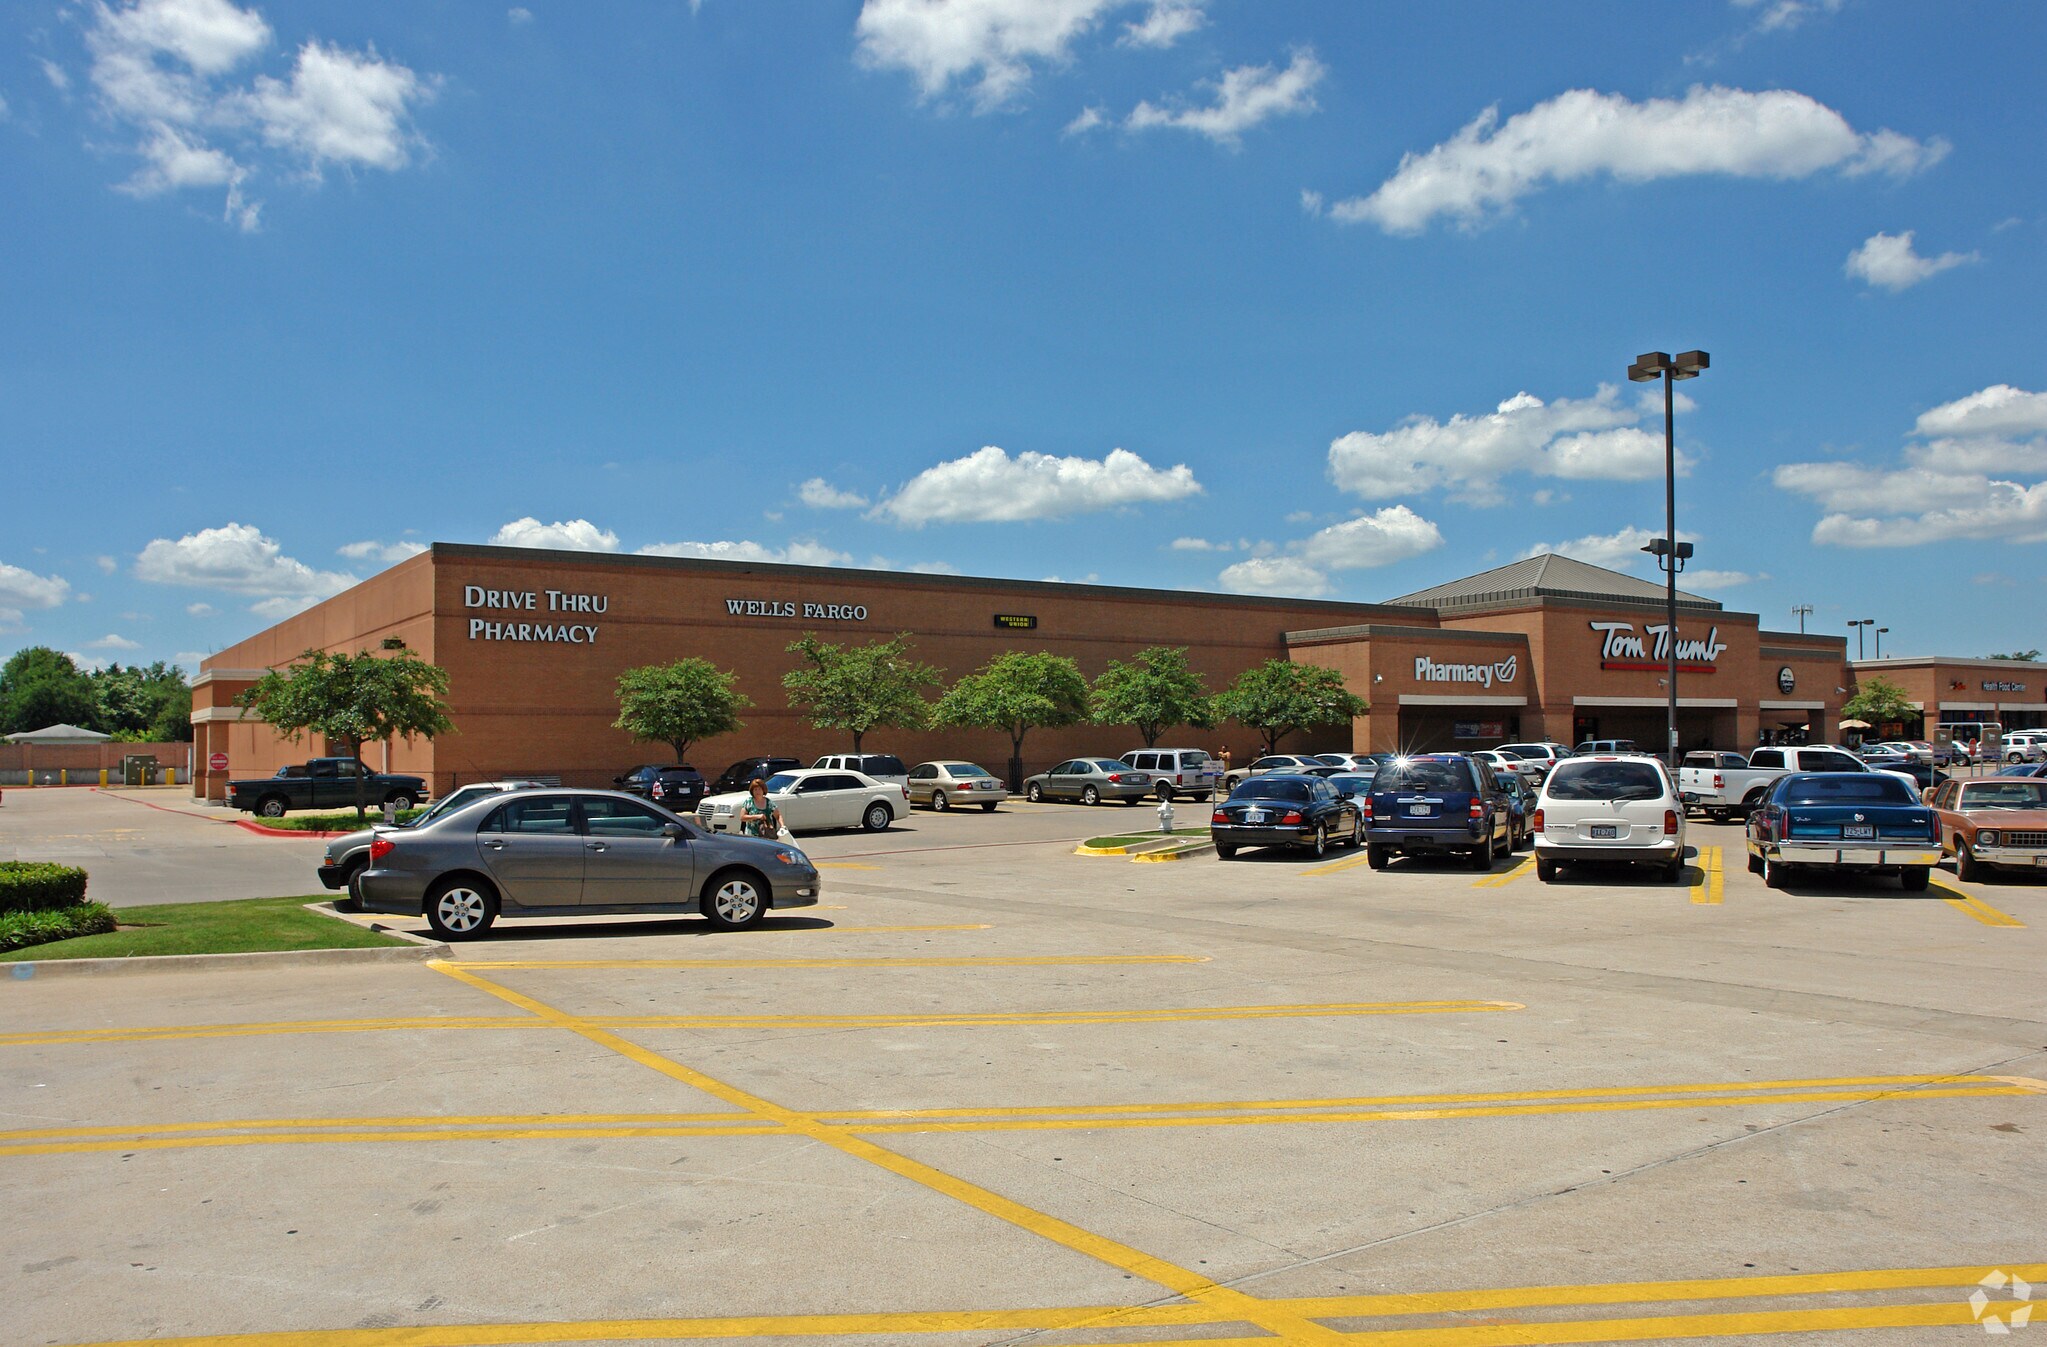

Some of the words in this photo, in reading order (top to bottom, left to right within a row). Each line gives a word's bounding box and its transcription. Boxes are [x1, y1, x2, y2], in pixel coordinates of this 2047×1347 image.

[464, 585, 537, 610] DRIVE
[545, 590, 608, 613] THRU
[726, 599, 796, 617] WELLS
[803, 603, 868, 620] FARGO
[468, 618, 599, 643] PHARMACY
[1589, 621, 1646, 659] Tom
[1415, 656, 1494, 689] Pharmacy
[1983, 681, 1998, 692] Health
[1998, 681, 2011, 692] Food
[2011, 682, 2026, 693] Center
